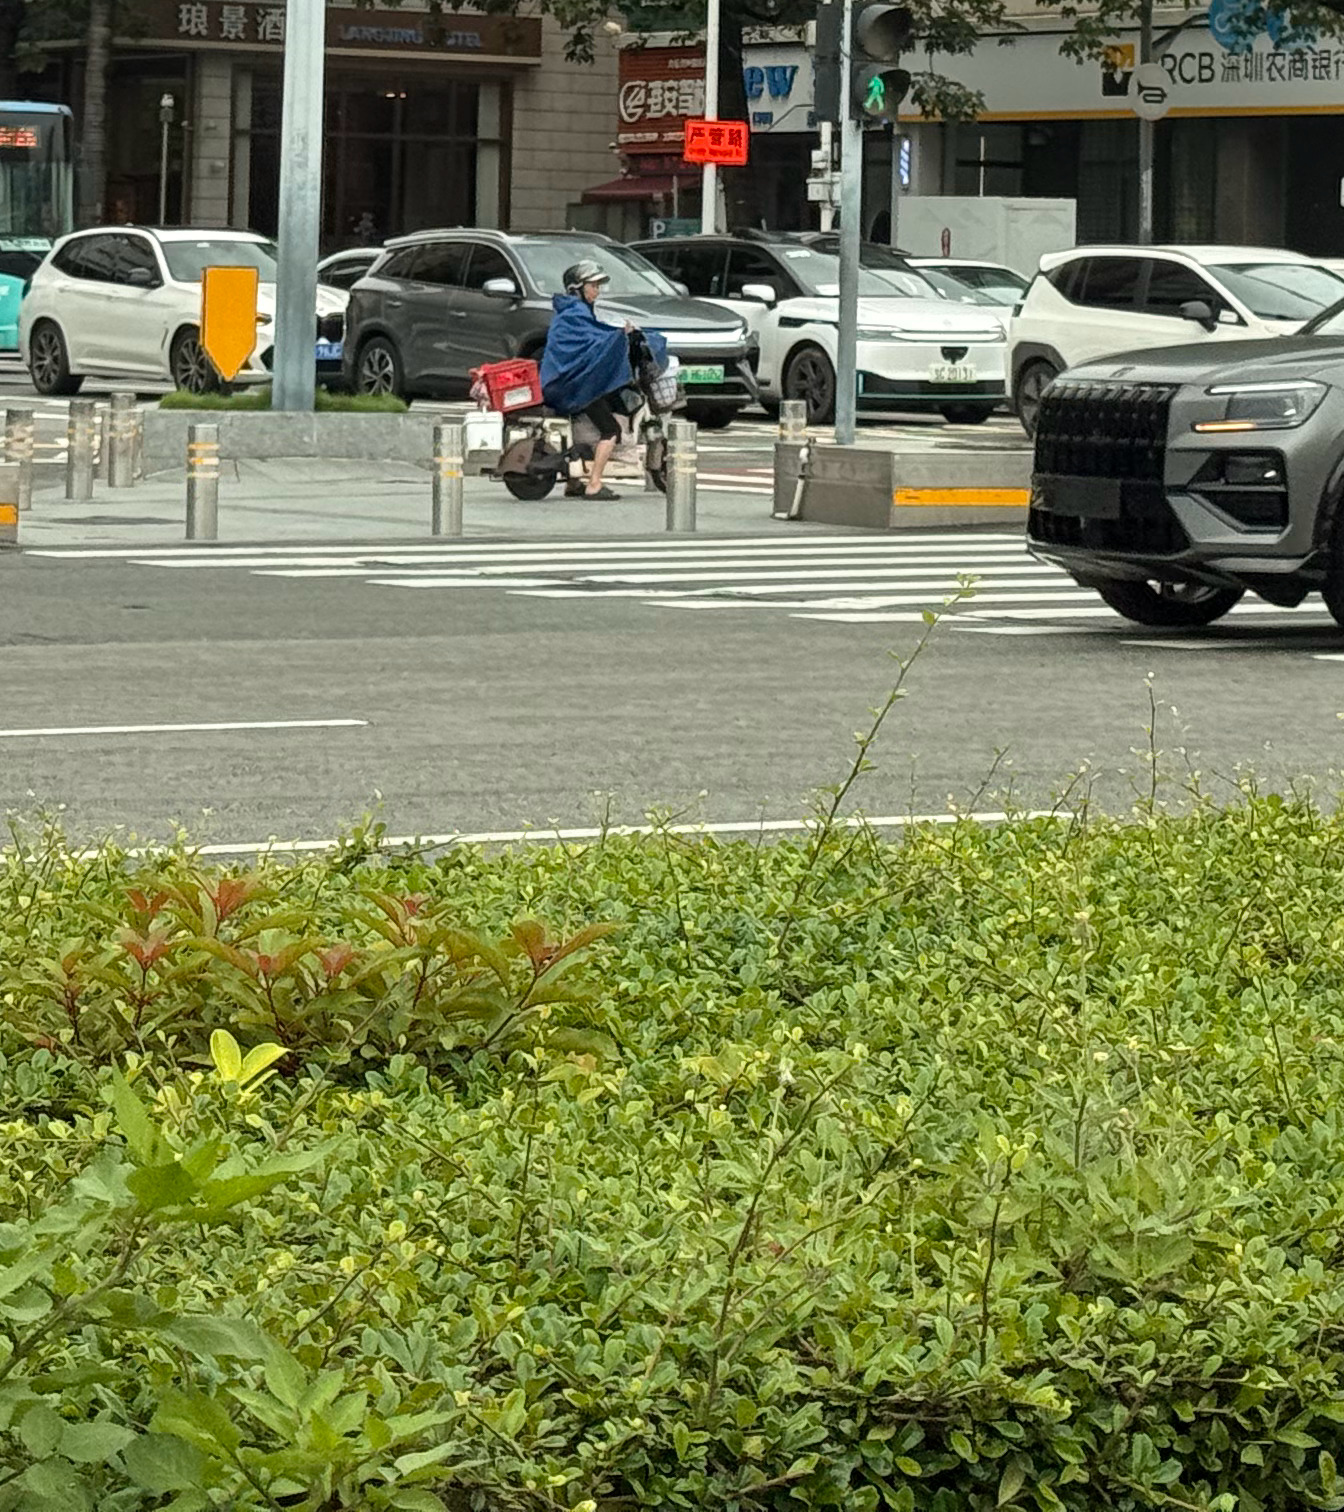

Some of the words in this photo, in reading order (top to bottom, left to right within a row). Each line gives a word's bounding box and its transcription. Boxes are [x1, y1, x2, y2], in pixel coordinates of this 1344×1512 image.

[177, 1, 287, 41] 琅景酒
[1160, 52, 1216, 85] RCB
